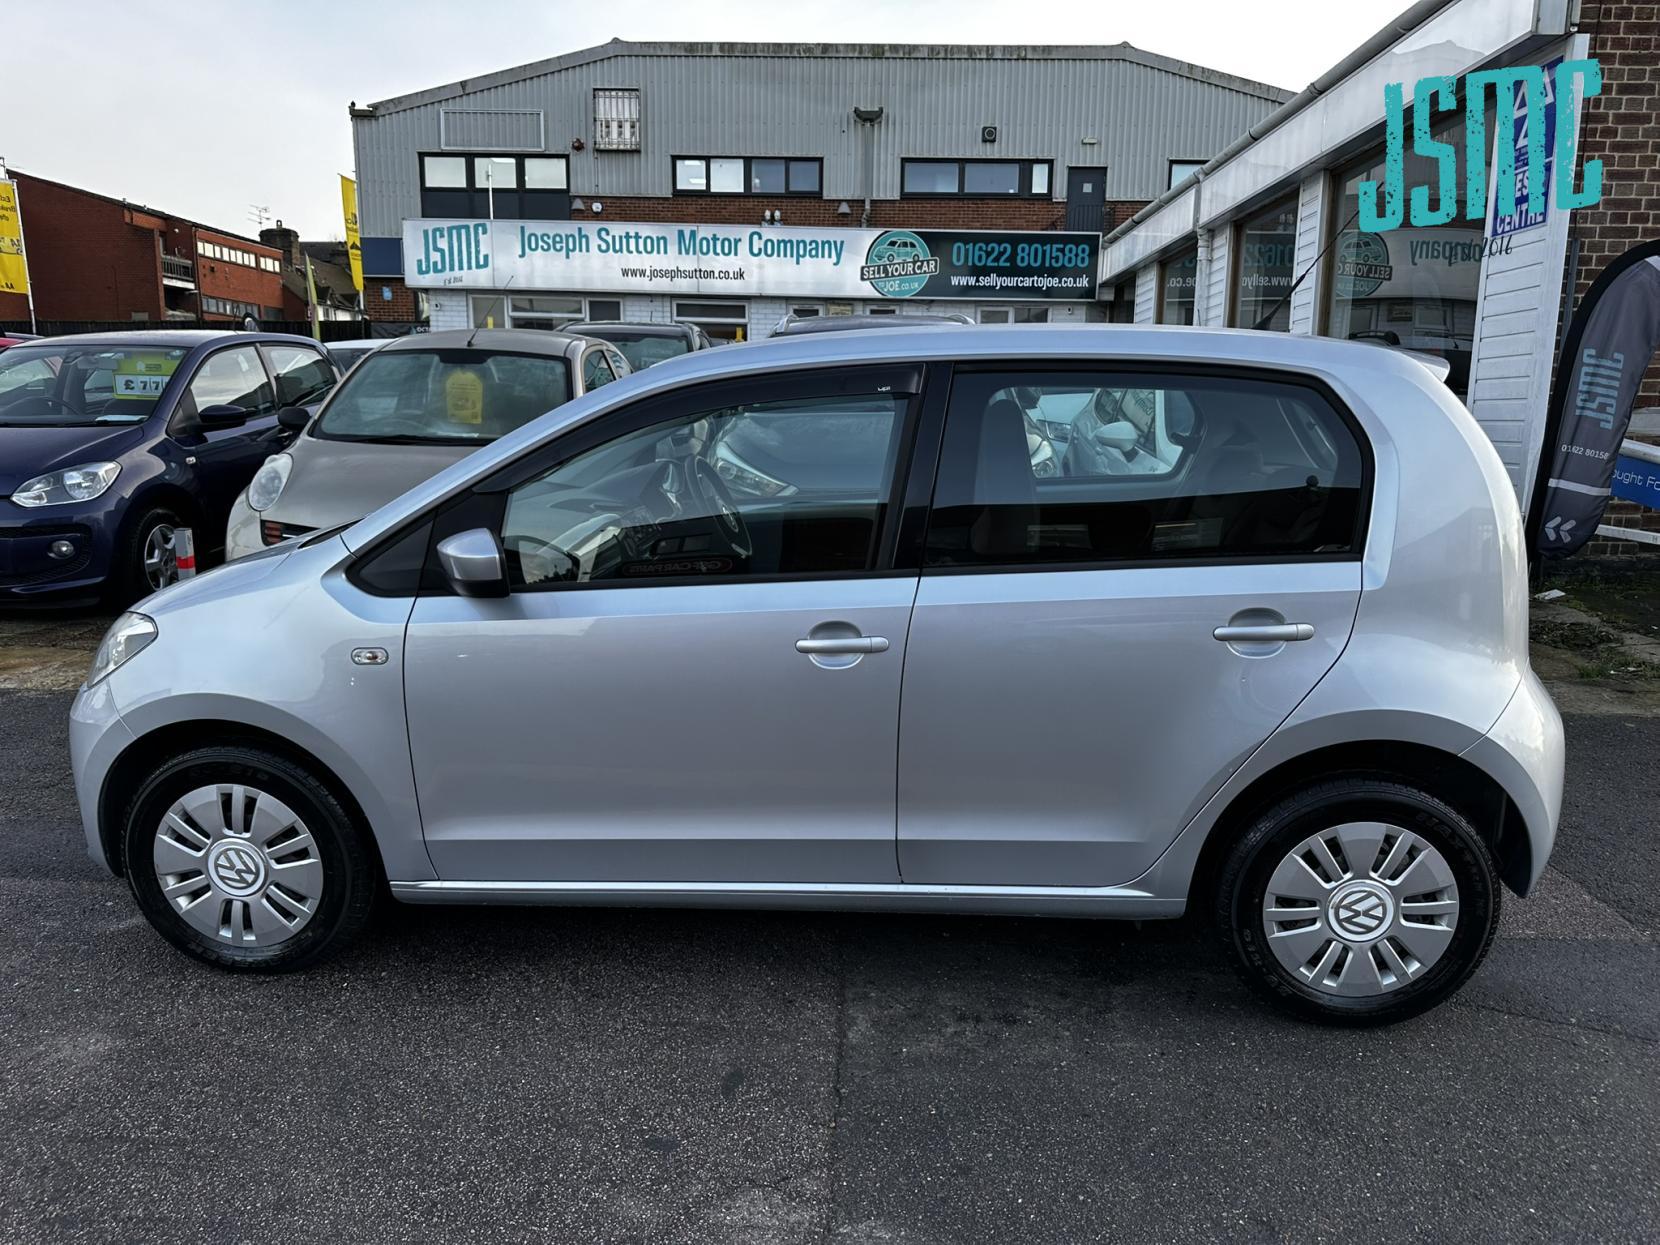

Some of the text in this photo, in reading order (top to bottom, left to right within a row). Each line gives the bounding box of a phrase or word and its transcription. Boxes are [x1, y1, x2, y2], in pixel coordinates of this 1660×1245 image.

[417, 222, 490, 276] JSMC
[518, 225, 844, 266] Joseph Sutton Motor Company
[952, 242, 1090, 268] 01622 801588
[620, 265, 745, 282] www.josephsutton.co.uk
[863, 260, 936, 280] SELL YOUR CAR
[950, 273, 1089, 290] www.sellyourcartojoe.co.uk
[1575, 348, 1624, 430] JSMC
